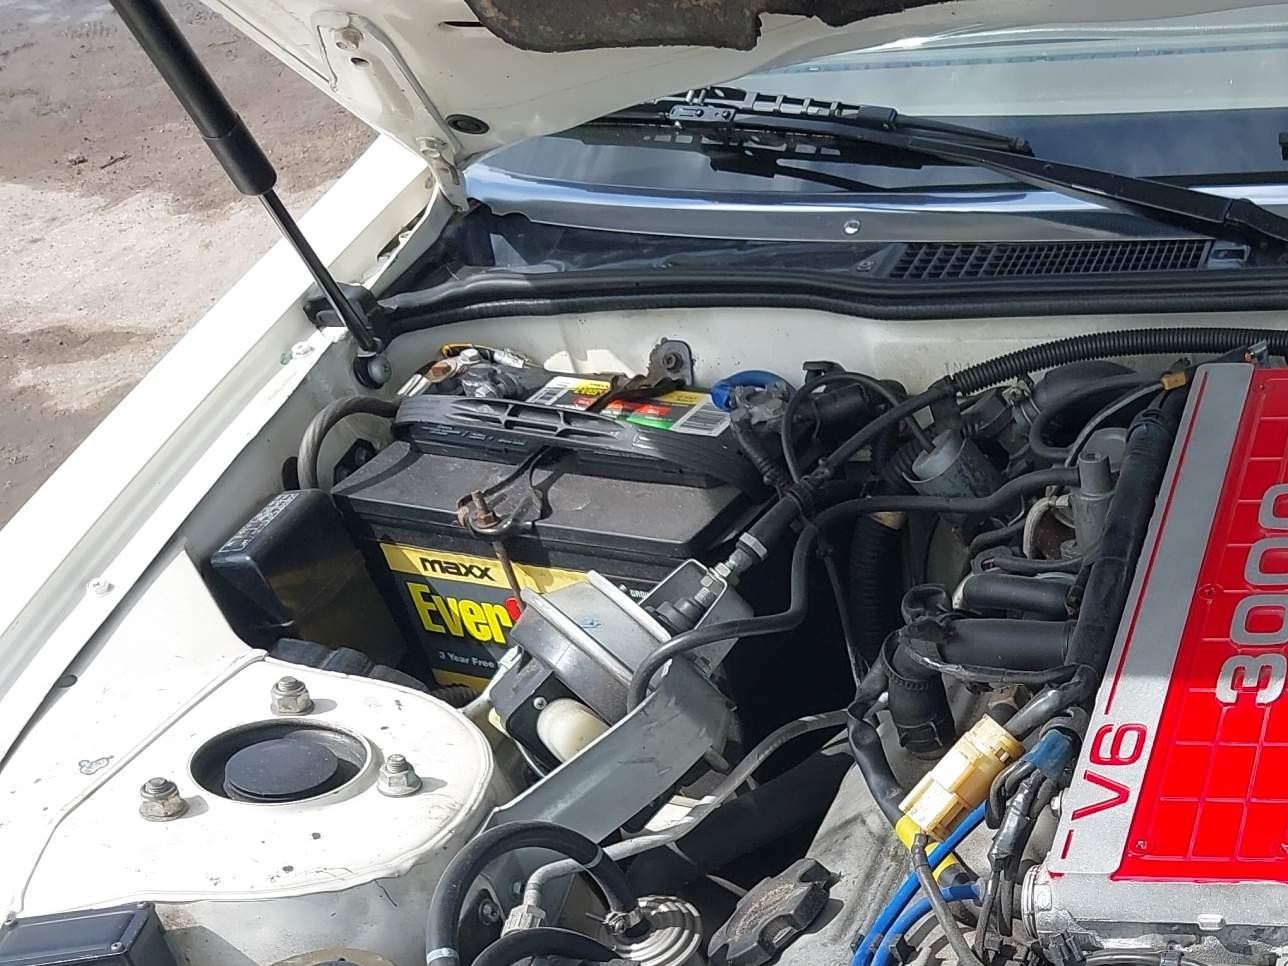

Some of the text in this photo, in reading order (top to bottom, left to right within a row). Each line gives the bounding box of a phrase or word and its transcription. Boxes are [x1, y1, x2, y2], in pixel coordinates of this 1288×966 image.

[419, 557, 496, 582] maxx
[450, 654, 469, 665] Year
[472, 657, 495, 669] Free
[1071, 722, 1147, 822] V6
